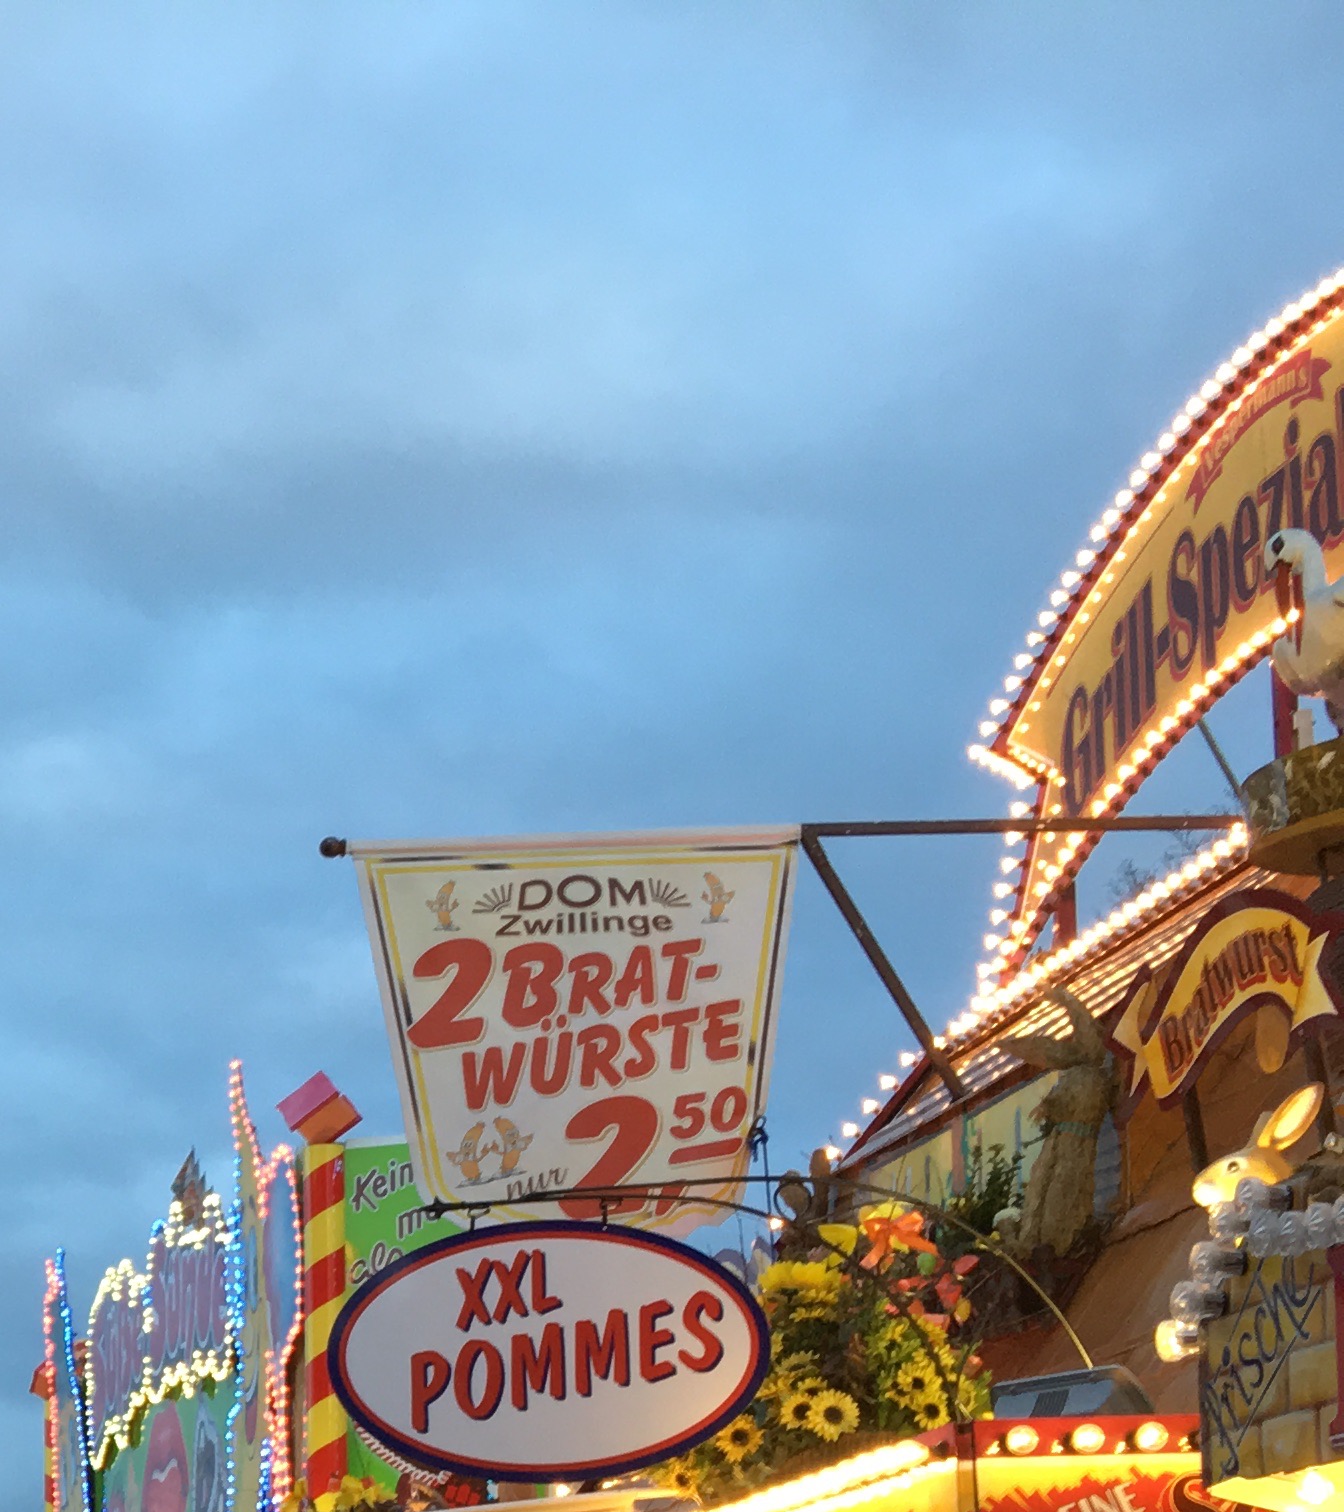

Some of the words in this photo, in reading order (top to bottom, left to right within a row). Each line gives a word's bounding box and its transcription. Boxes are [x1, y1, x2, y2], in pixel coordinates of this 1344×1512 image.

[495, 911, 672, 937] Zwillinge
[518, 875, 647, 909] DOM
[408, 938, 492, 1049] 2
[501, 938, 717, 1030] BRAT-
[1161, 920, 1304, 1084] Bratwurst
[462, 1000, 741, 1112] WÜRSTE
[505, 1163, 568, 1200] nur
[453, 1248, 562, 1334] XXL
[410, 1289, 725, 1434] POMMES
